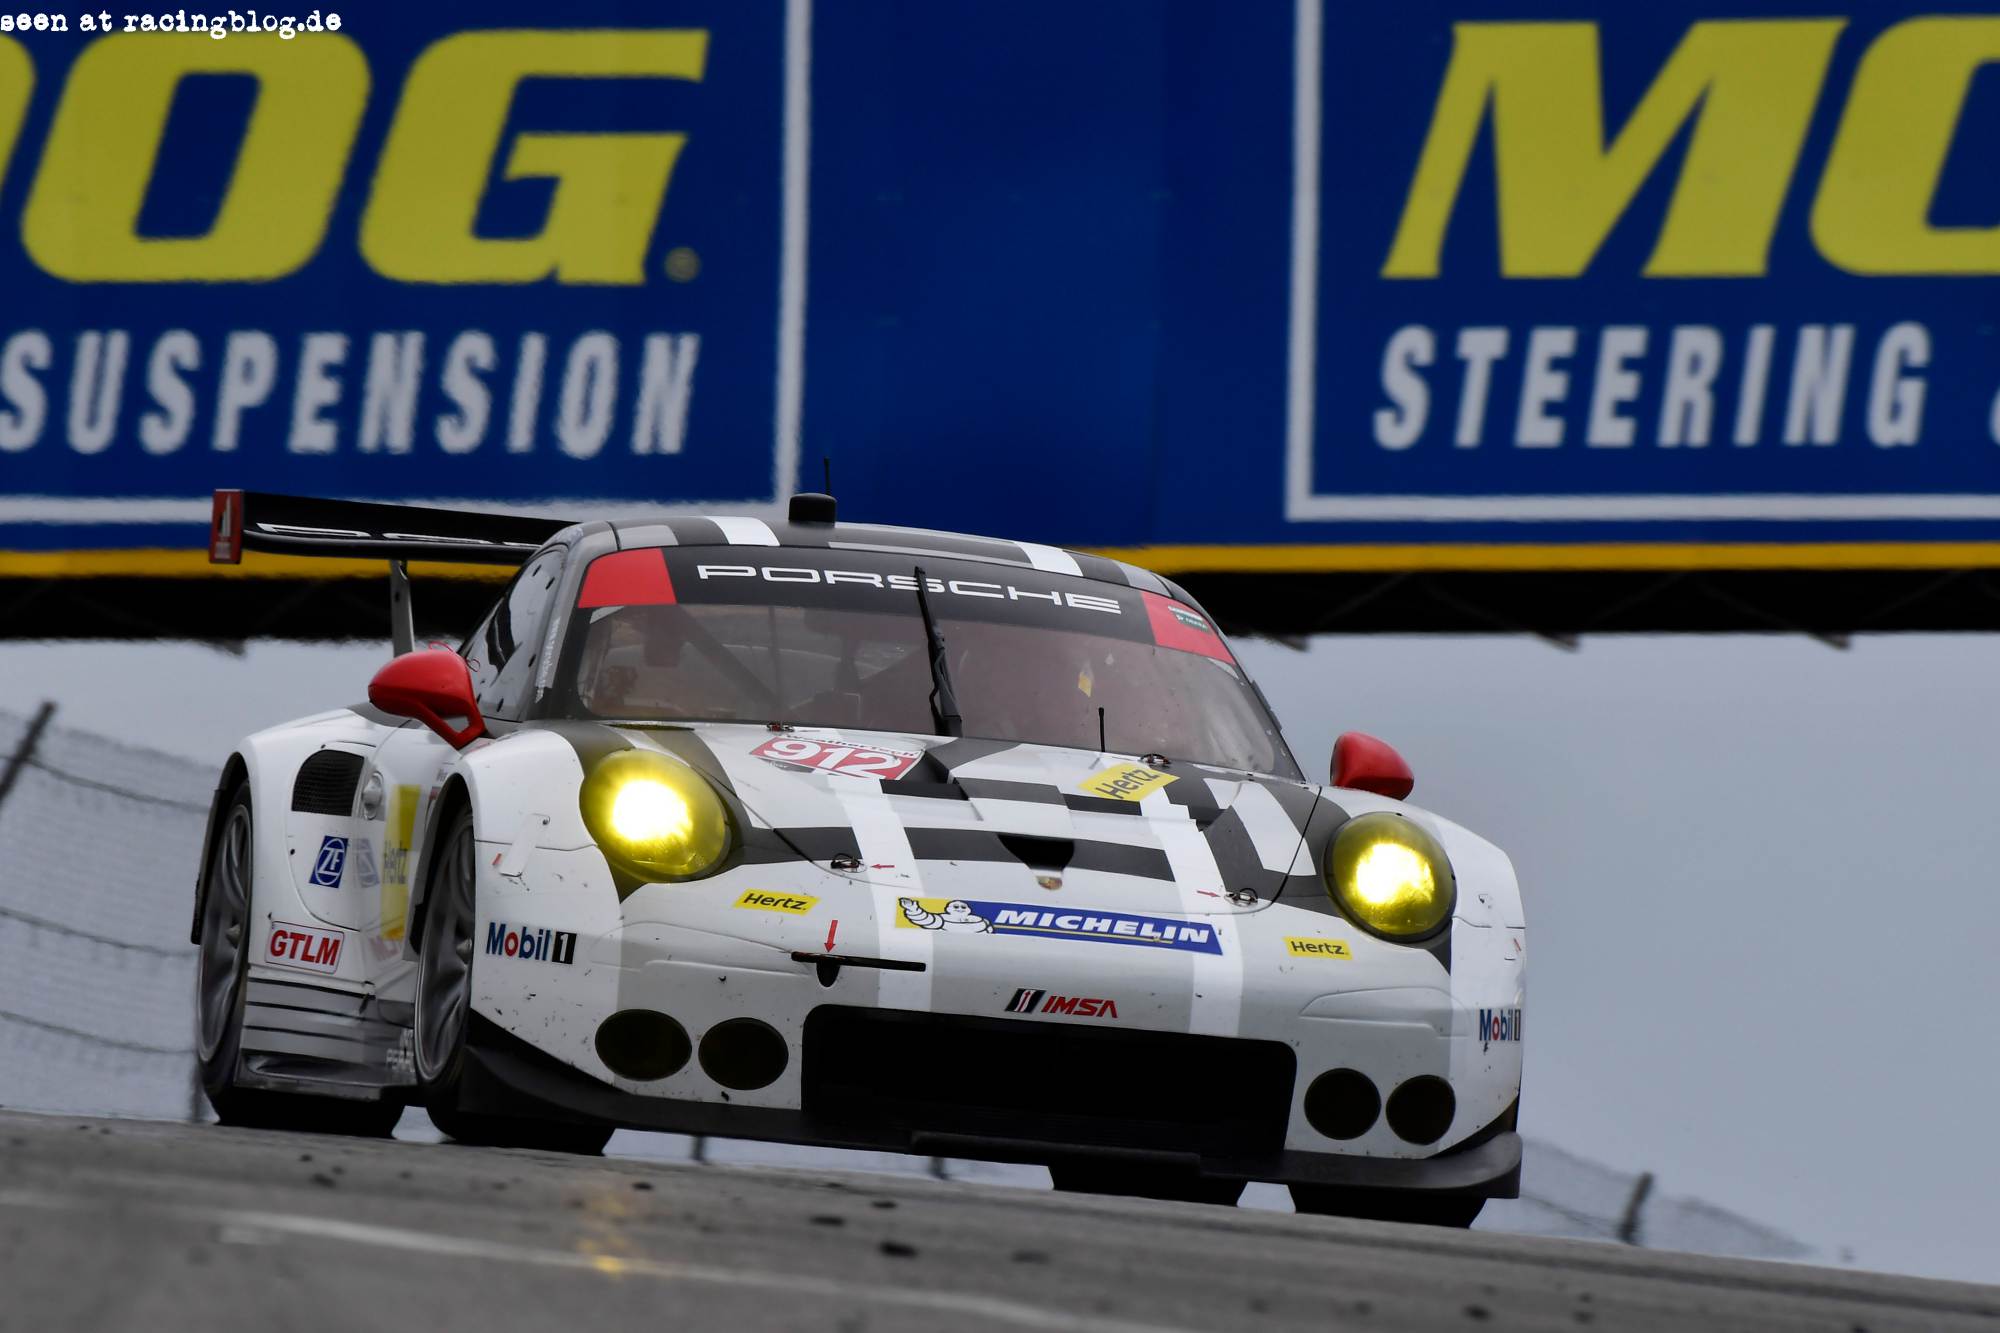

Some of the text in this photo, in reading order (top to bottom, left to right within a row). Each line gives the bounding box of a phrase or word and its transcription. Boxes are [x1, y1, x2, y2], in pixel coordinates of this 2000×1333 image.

[0, 29, 710, 285] OG
[0, 329, 699, 459] SUSPENSION
[1373, 322, 1932, 451] STEERING
[697, 564, 1122, 615] PORSCHE
[763, 739, 901, 780] 912
[485, 921, 552, 962] Mobil
[994, 909, 1210, 944] MICHELIN
[270, 929, 341, 967] GTLM
[1041, 995, 1118, 1019] IMSA
[1479, 1008, 1514, 1042] Mobil
